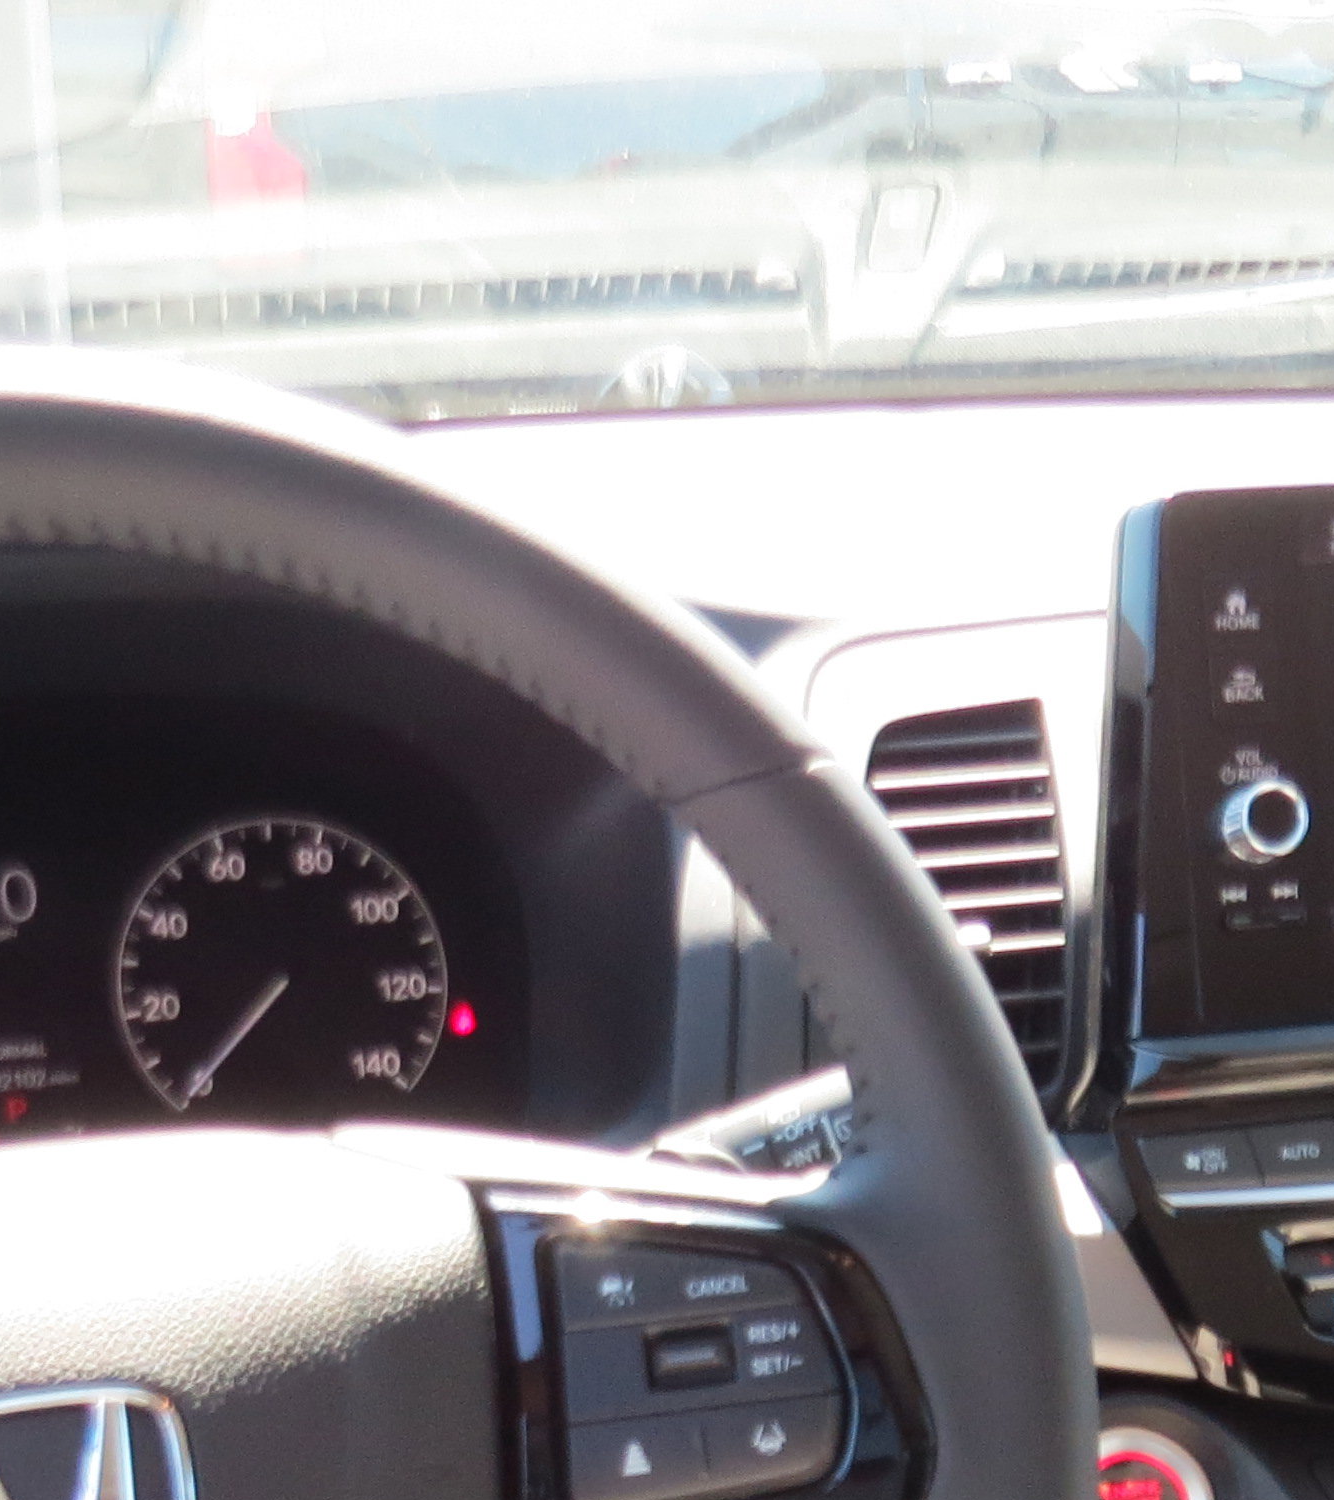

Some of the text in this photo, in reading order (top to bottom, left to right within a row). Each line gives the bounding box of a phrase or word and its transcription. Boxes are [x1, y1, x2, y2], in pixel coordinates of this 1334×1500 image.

[1216, 612, 1261, 631] HOME
[1223, 686, 1265, 703] BACK
[208, 850, 246, 882] 60
[294, 847, 334, 876] 80
[0, 868, 37, 923] 0
[350, 892, 400, 924] 100
[149, 910, 189, 940] 40
[376, 970, 427, 1001] 120
[140, 988, 181, 1023] 20
[351, 1046, 402, 1080] 140
[1280, 1142, 1321, 1161] AUTO
[686, 1273, 749, 1299] CANCEL
